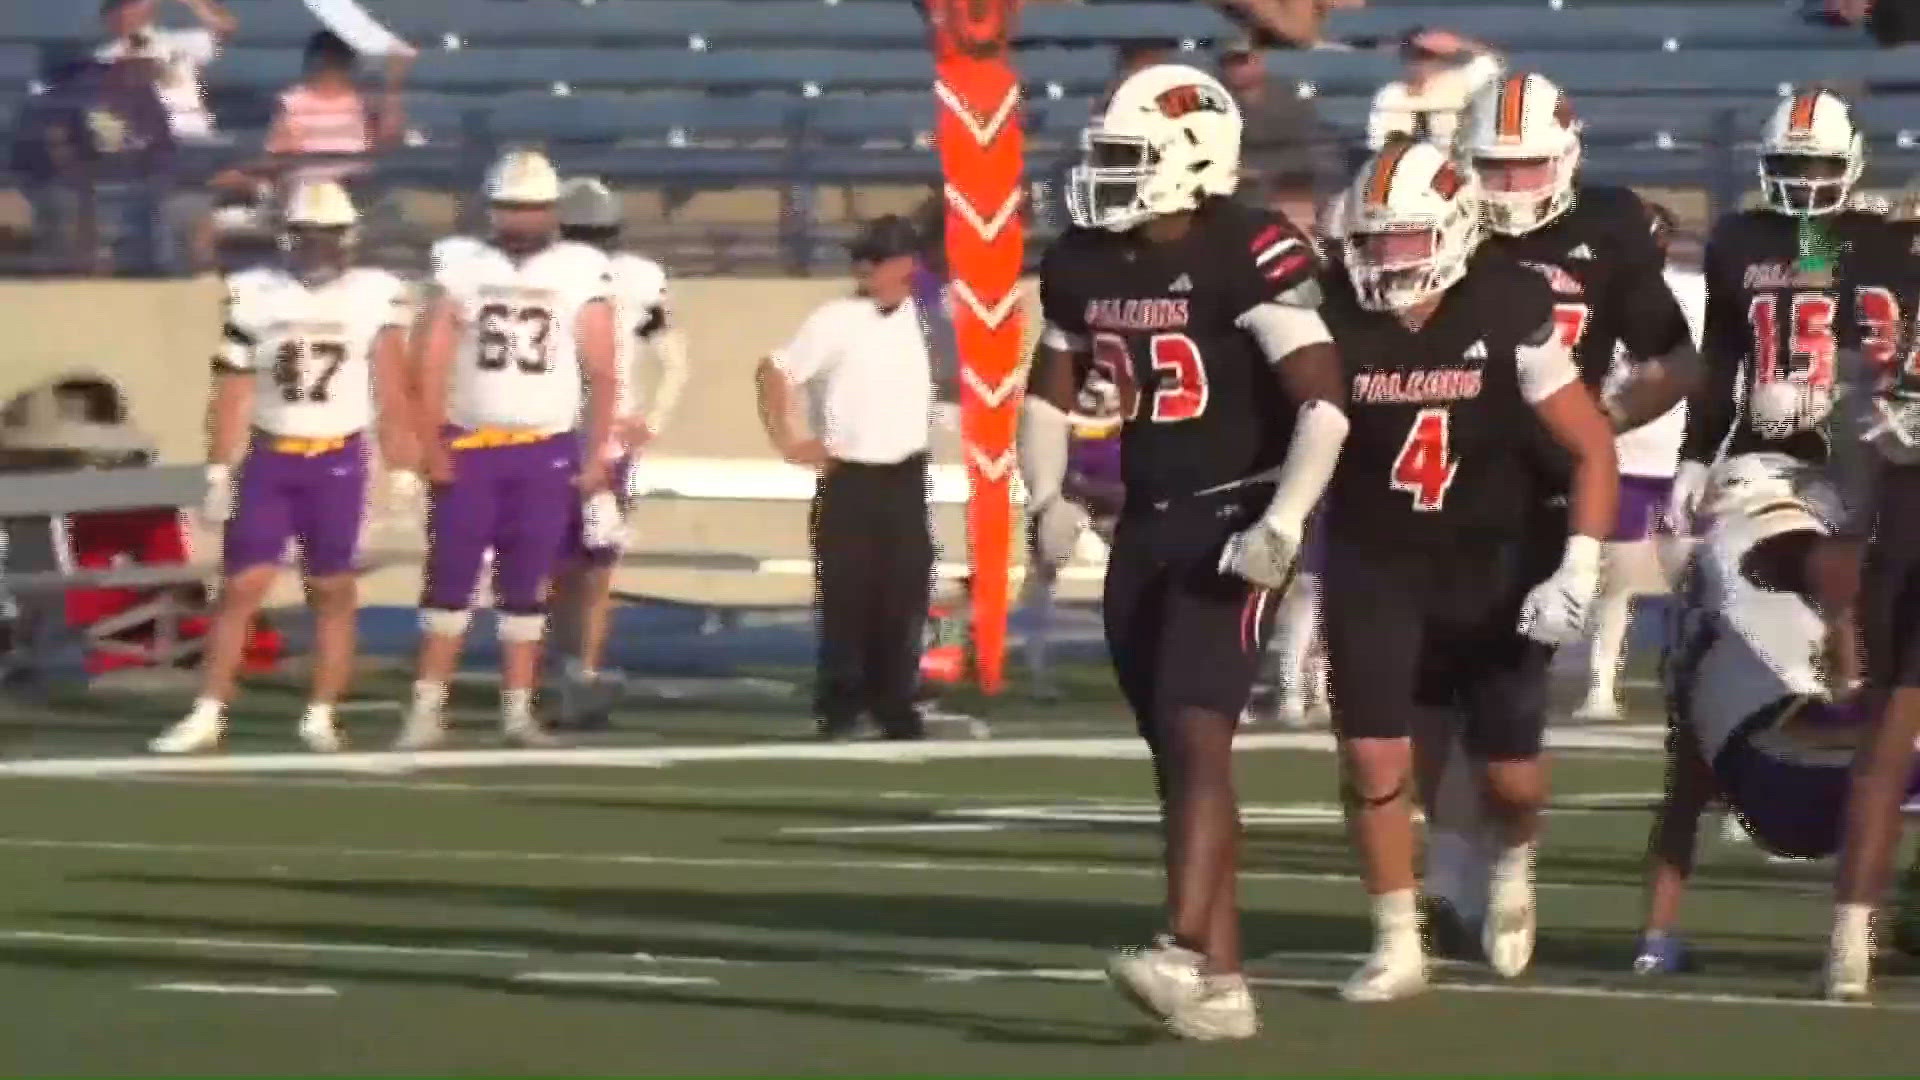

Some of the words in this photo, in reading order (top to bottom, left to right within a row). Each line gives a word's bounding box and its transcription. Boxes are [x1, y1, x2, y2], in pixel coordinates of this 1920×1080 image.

[476, 303, 552, 375] 63
[1748, 293, 1837, 386] 15
[1390, 408, 1461, 512] 4
